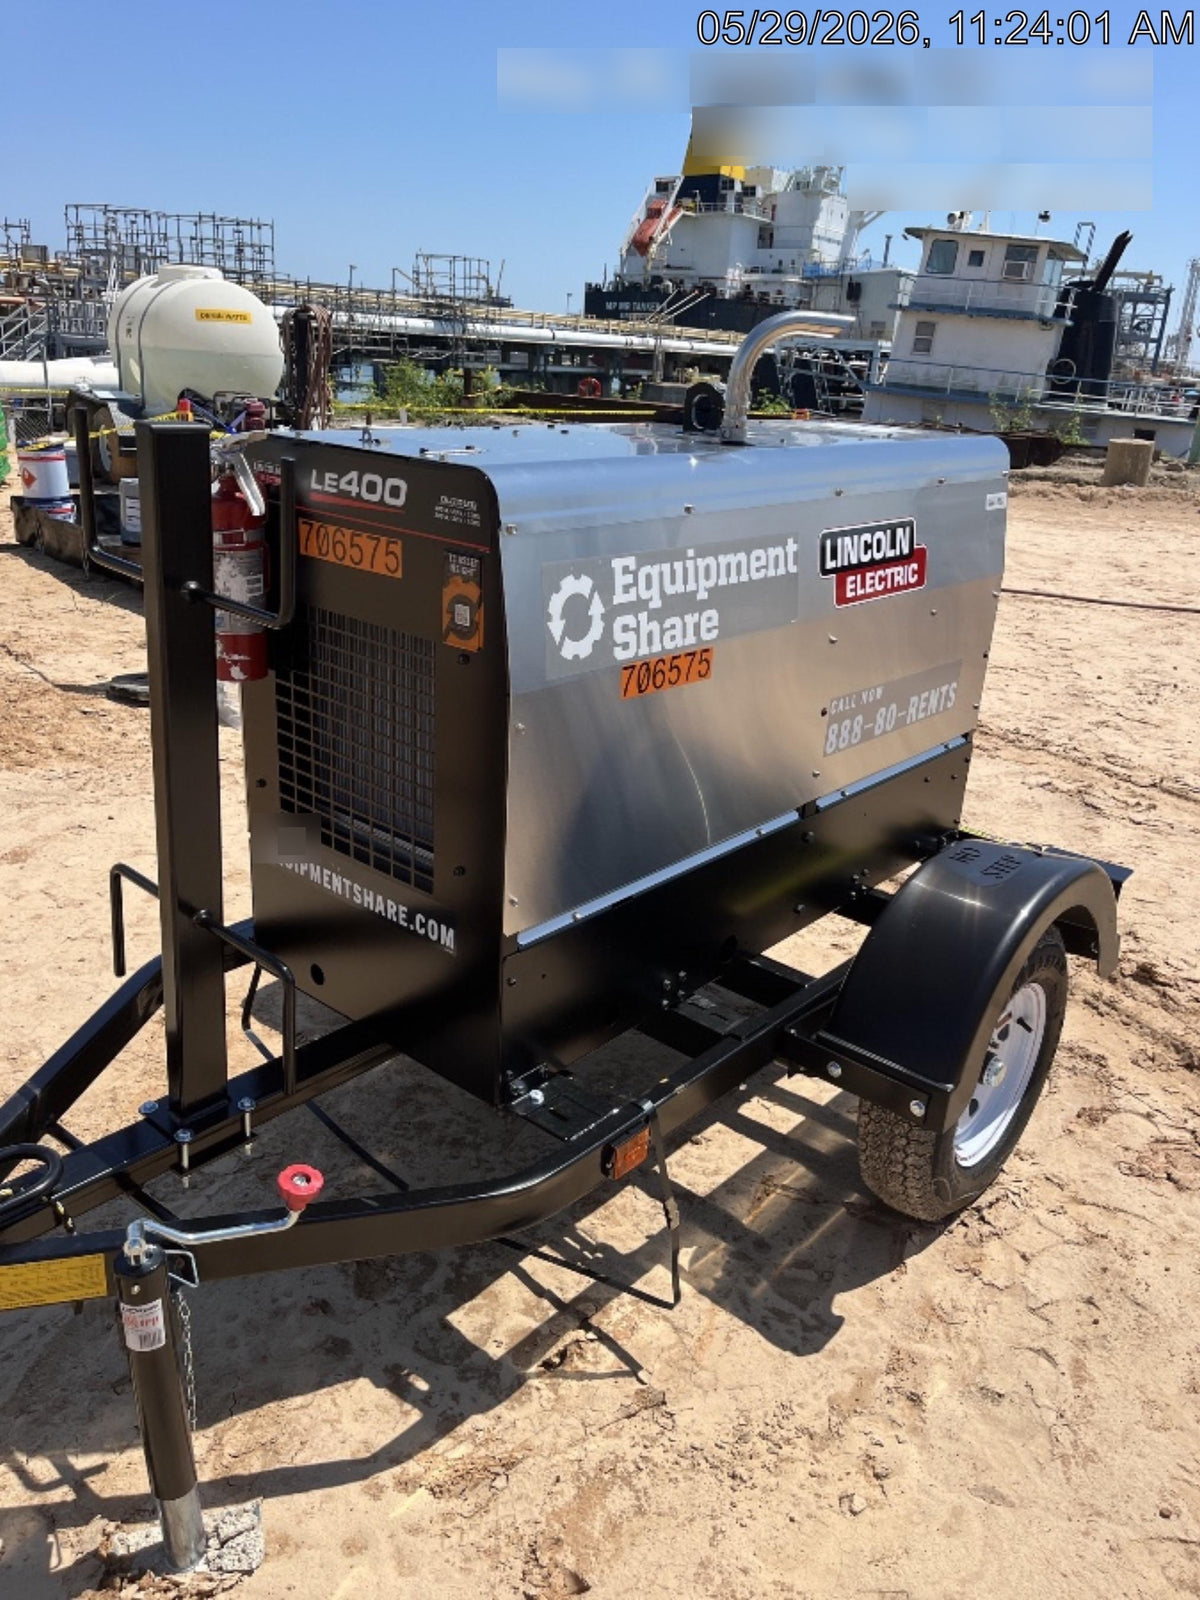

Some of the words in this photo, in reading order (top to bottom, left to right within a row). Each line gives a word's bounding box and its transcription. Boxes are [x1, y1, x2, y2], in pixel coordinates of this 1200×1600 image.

[310, 468, 408, 507] LE400
[301, 521, 400, 575] 706575
[825, 526, 911, 570] LINCOLN
[611, 537, 799, 609] Equipment
[846, 562, 919, 599] ELECTRIC
[612, 608, 720, 661] Share
[622, 648, 711, 697] 706575
[825, 681, 958, 755] 888-80-RENTS
[831, 694, 857, 715] CALL
[860, 686, 885, 705] NOW
[948, 846, 981, 865] NO
[980, 853, 1022, 880] STEP
